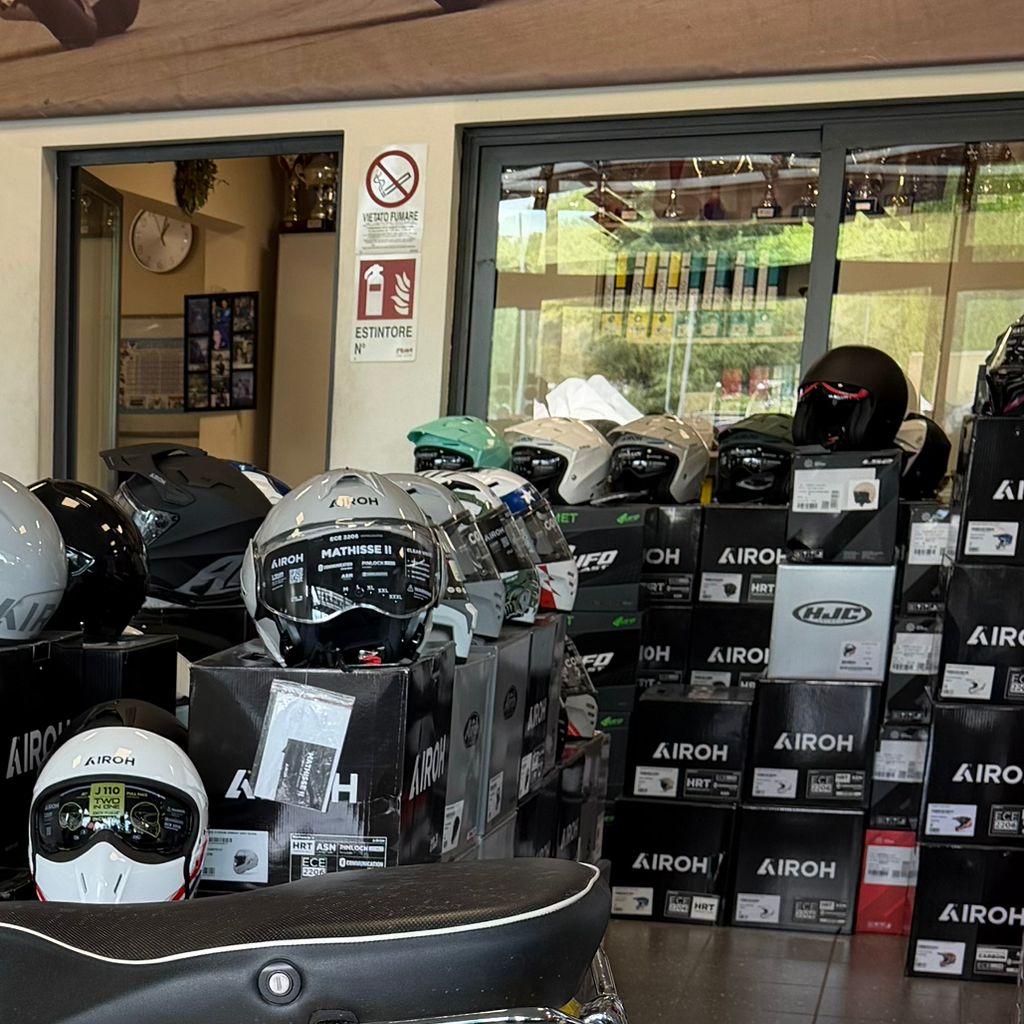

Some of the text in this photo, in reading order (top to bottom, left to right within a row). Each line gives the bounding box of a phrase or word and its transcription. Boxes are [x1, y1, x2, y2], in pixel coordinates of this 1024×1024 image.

[363, 211, 418, 222] VIETATO FUMARE
[356, 326, 412, 338] ESTINTORE
[321, 545, 392, 559] MATHISSE II
[271, 553, 304, 569] AIROH
[803, 606, 863, 621] HJC
[773, 732, 853, 752] AIROH
[5, 720, 71, 780] AIRO
[653, 742, 728, 762] AIROH
[84, 755, 136, 767] AIROH
[409, 734, 447, 800] AIROH
[952, 763, 1024, 784] AIRO
[95, 787, 120, 795] J 110
[687, 778, 711, 789] HRT
[316, 842, 336, 852] ASN
[302, 857, 326, 867] ECE
[632, 853, 708, 874] AIROH
[757, 858, 836, 879] AIROH
[694, 903, 715, 912] HRT
[938, 903, 1024, 926] AIROH
